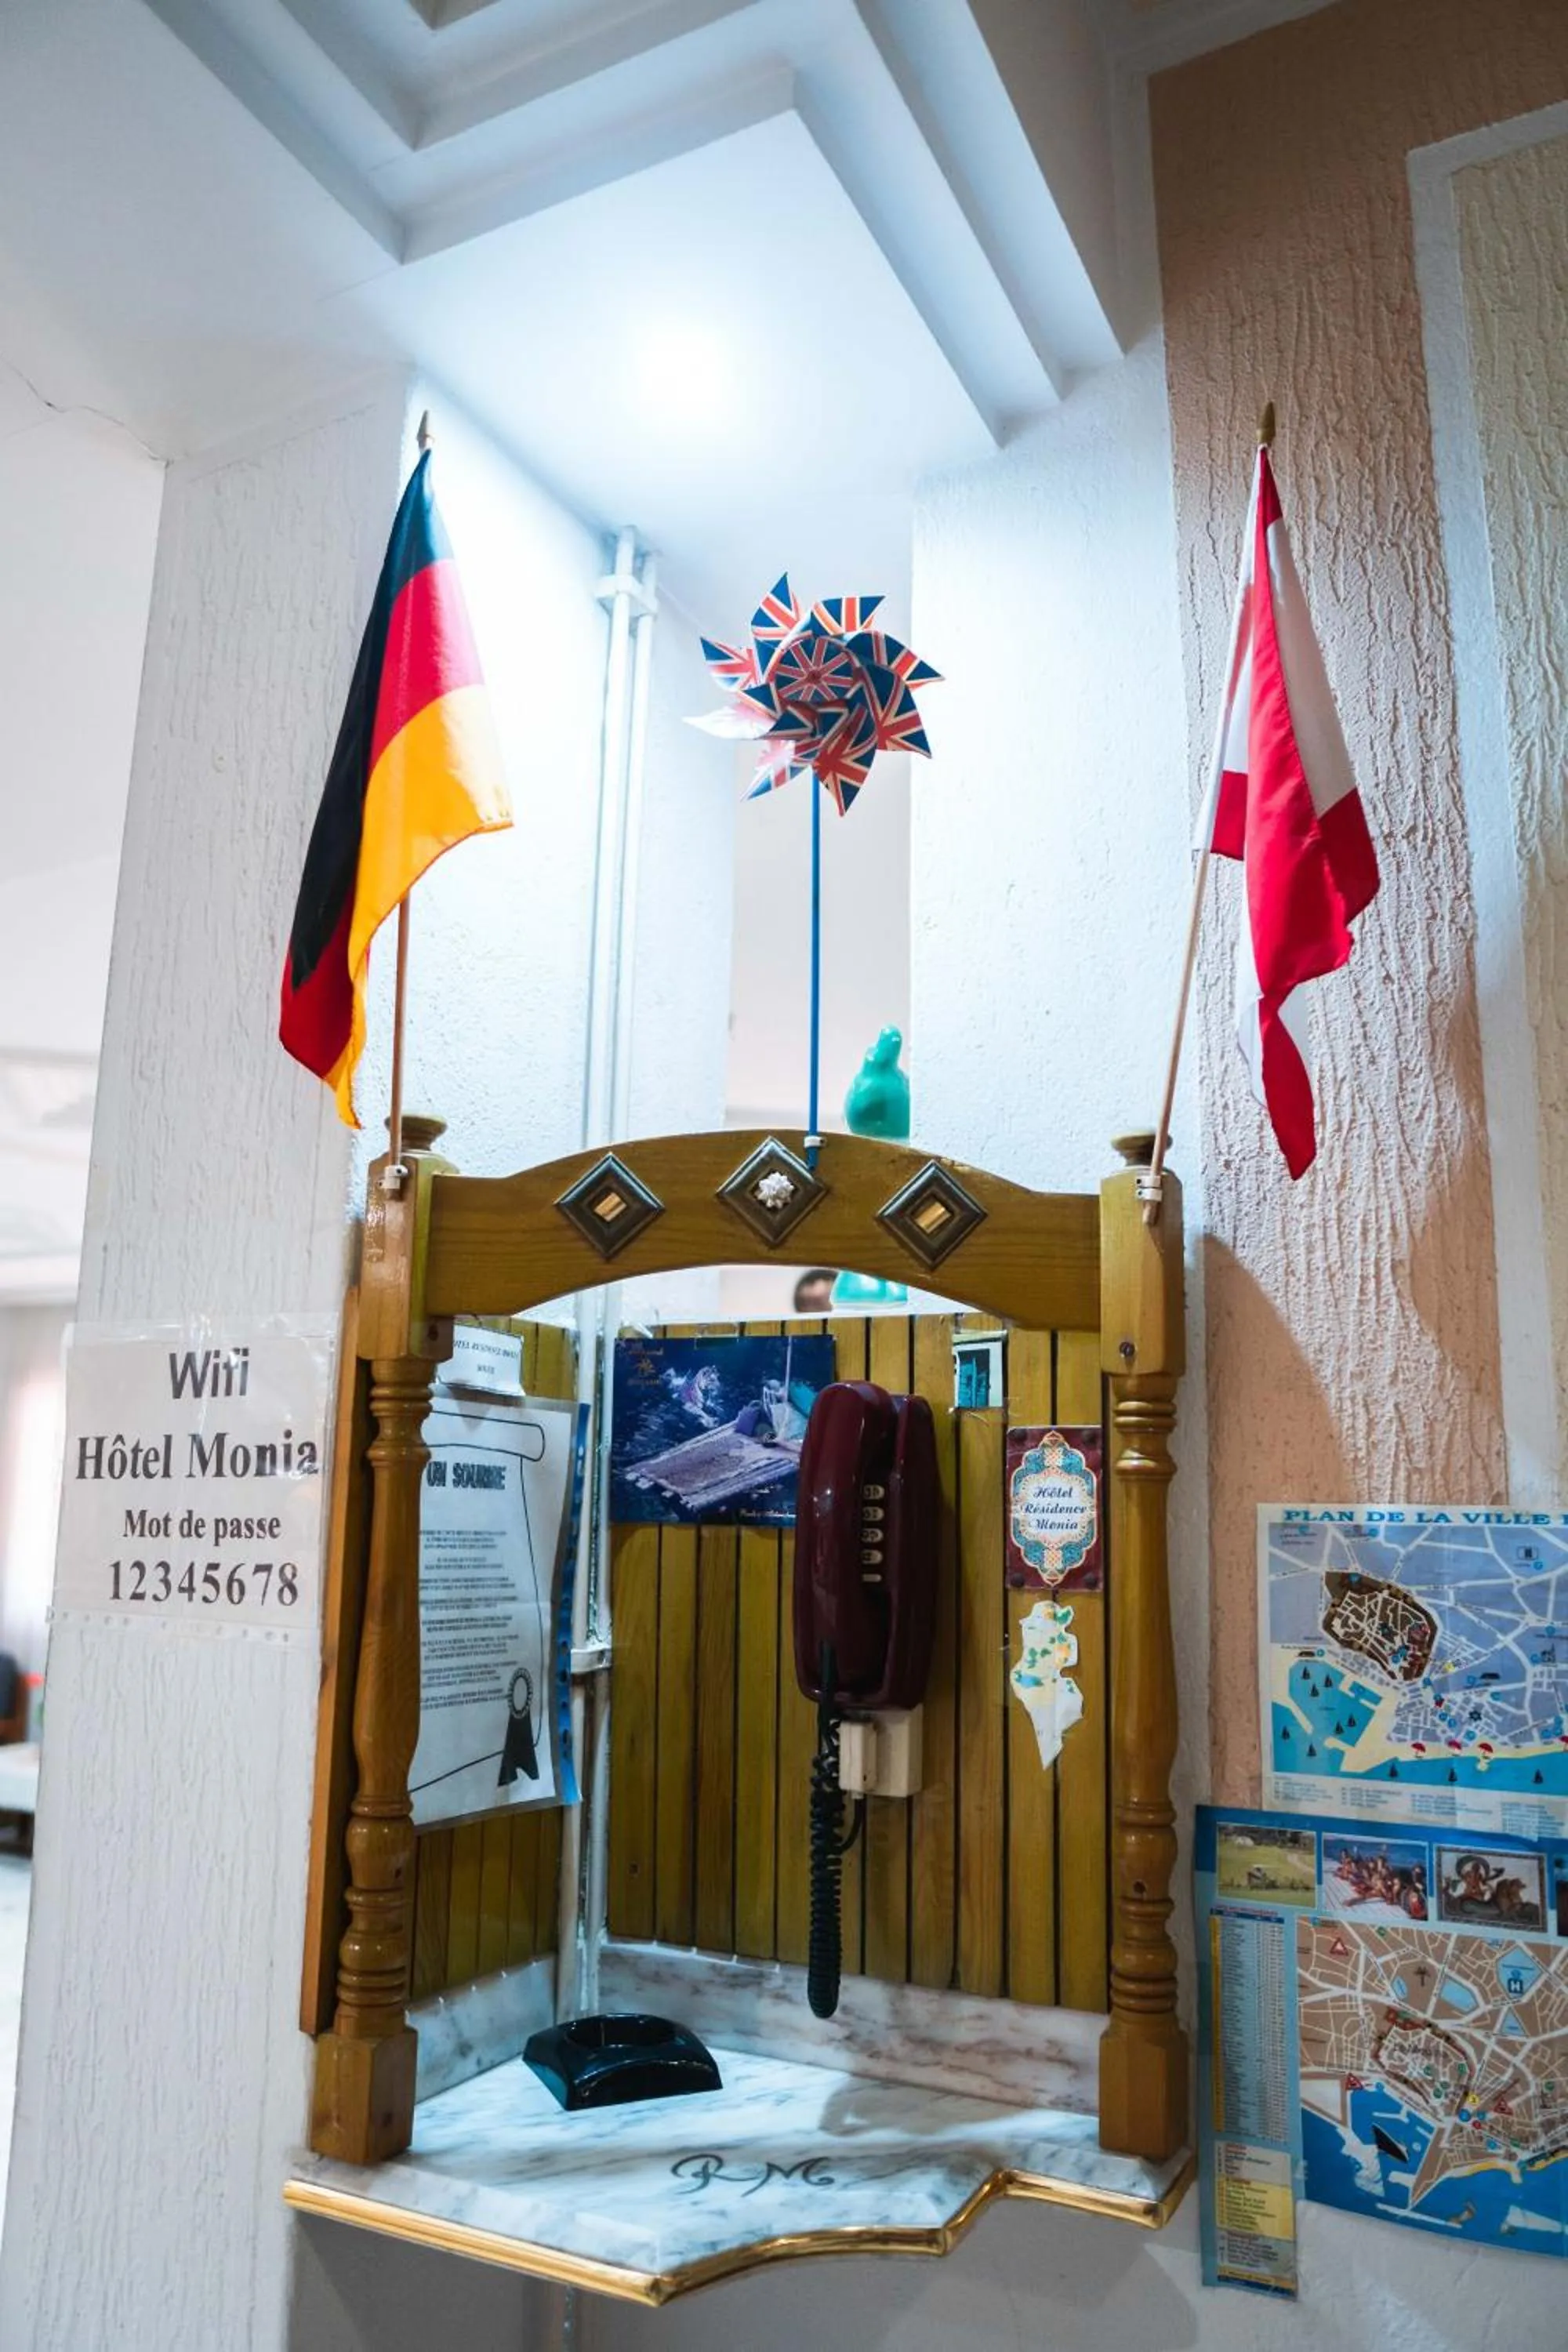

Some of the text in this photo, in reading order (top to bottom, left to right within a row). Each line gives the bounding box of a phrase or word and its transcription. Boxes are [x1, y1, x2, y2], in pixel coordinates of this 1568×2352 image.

[169, 1347, 249, 1399] Wifi
[76, 1429, 319, 1479] Hôtel Monia
[1034, 1486, 1073, 1498] Hôtel
[122, 1509, 281, 1546] Mot de passe
[1034, 1519, 1078, 1530] Monia
[1284, 1509, 1355, 1522] PLAN
[1367, 1511, 1405, 1523] DE
[1416, 1512, 1453, 1524] LA
[1462, 1512, 1550, 1525] VILLE
[109, 1560, 299, 1606] 12345678
